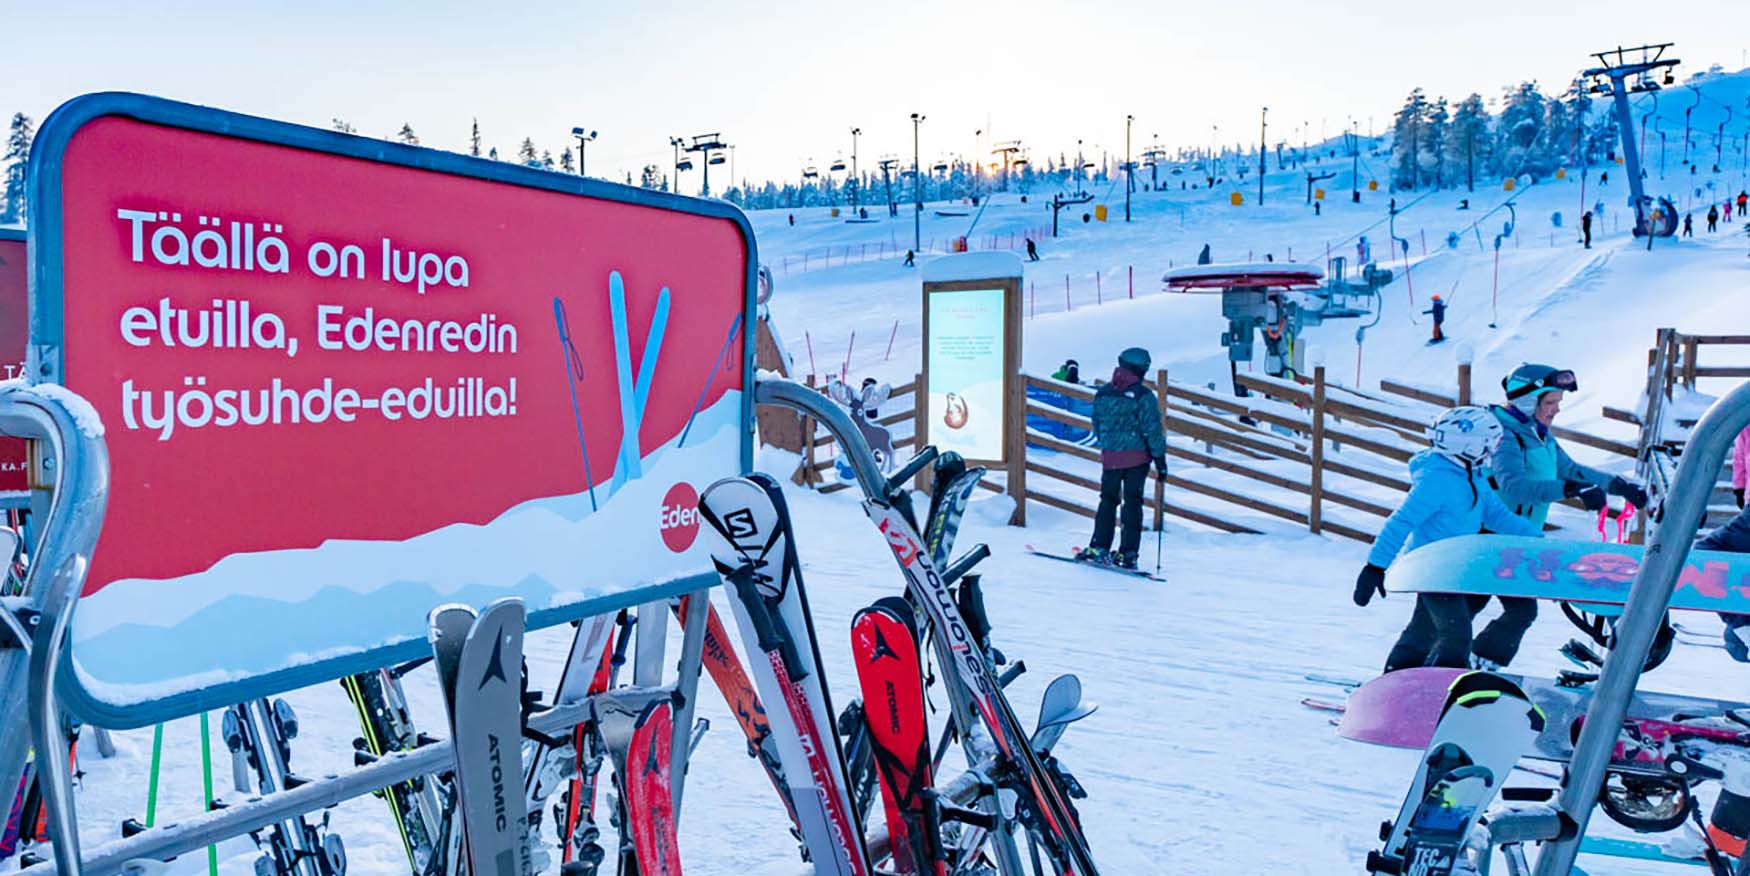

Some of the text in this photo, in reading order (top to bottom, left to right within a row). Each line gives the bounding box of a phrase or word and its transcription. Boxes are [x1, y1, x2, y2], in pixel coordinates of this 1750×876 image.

[117, 208, 469, 294] Täällä on lupa
[120, 297, 517, 358] etuilla, Edenredin
[122, 376, 517, 441] työsuhde-eduilla!
[915, 550, 992, 695] salomon
[885, 679, 901, 735] ATOMIC
[487, 733, 507, 833] ATOMIC
